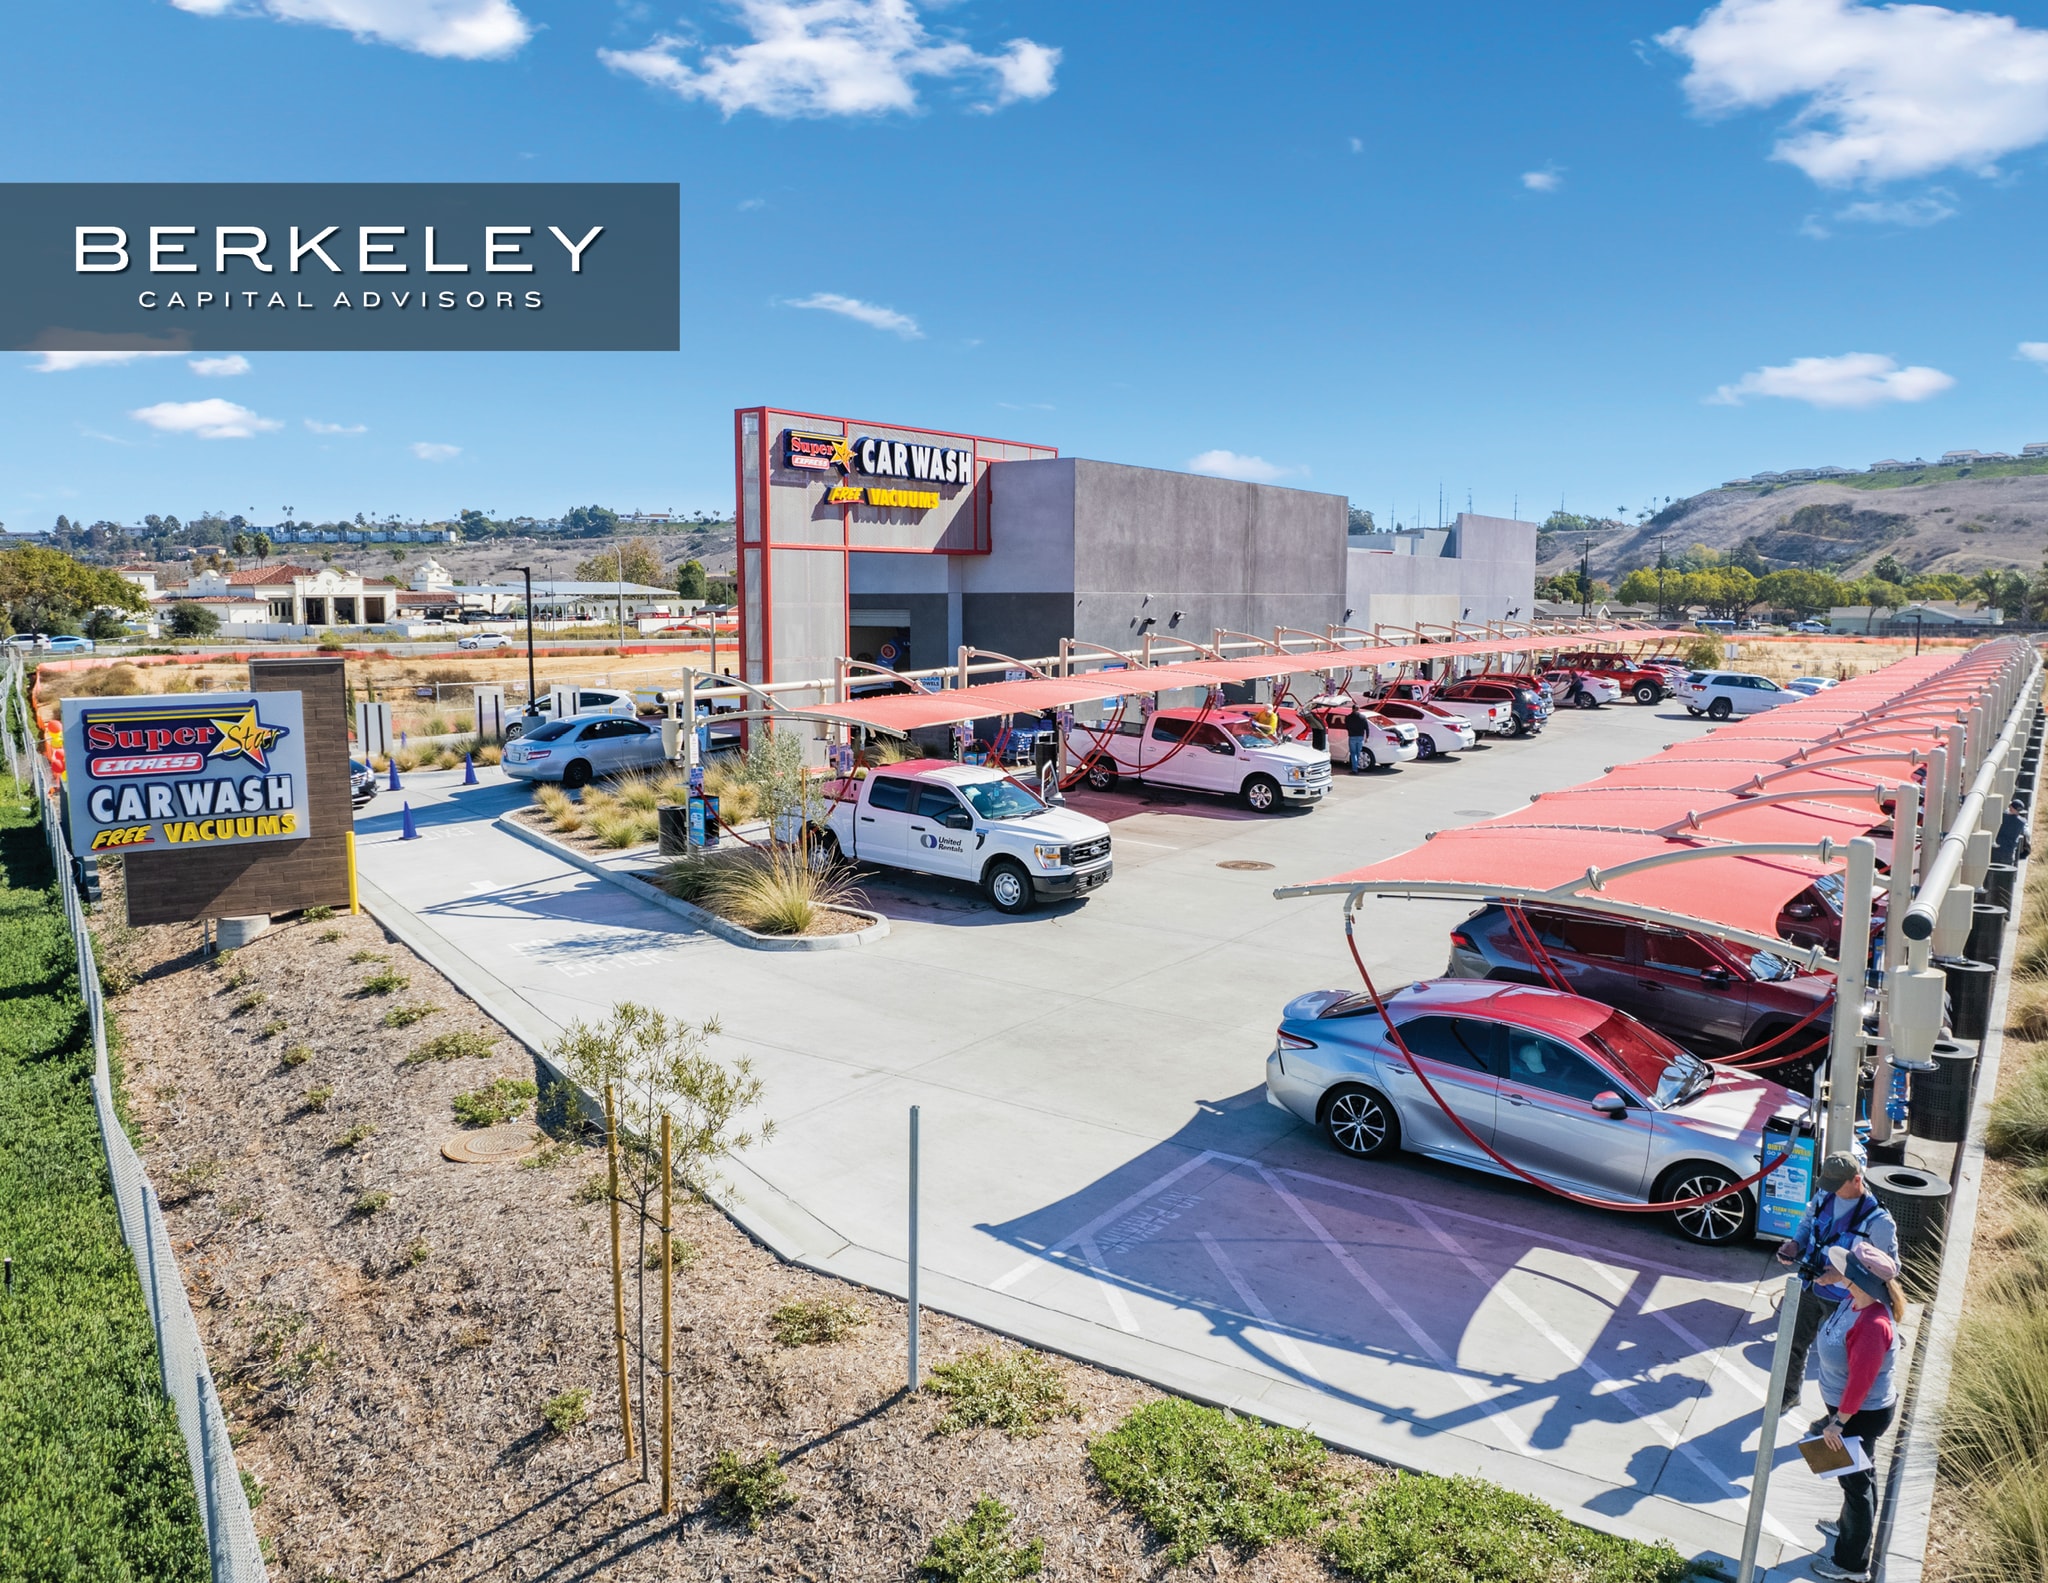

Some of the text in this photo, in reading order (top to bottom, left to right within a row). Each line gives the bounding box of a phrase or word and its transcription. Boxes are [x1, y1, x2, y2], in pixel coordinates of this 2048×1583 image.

[791, 437, 835, 456] Super
[862, 440, 972, 483] CAR WASH
[828, 486, 939, 509] FREE VACUUMS
[88, 723, 281, 757] Super Star
[97, 755, 200, 772] EXPRESS
[90, 776, 293, 823] CAR WASH
[91, 813, 297, 850] FREE VACUUMS
[938, 836, 962, 846] United
[938, 844, 964, 853] Rentals
